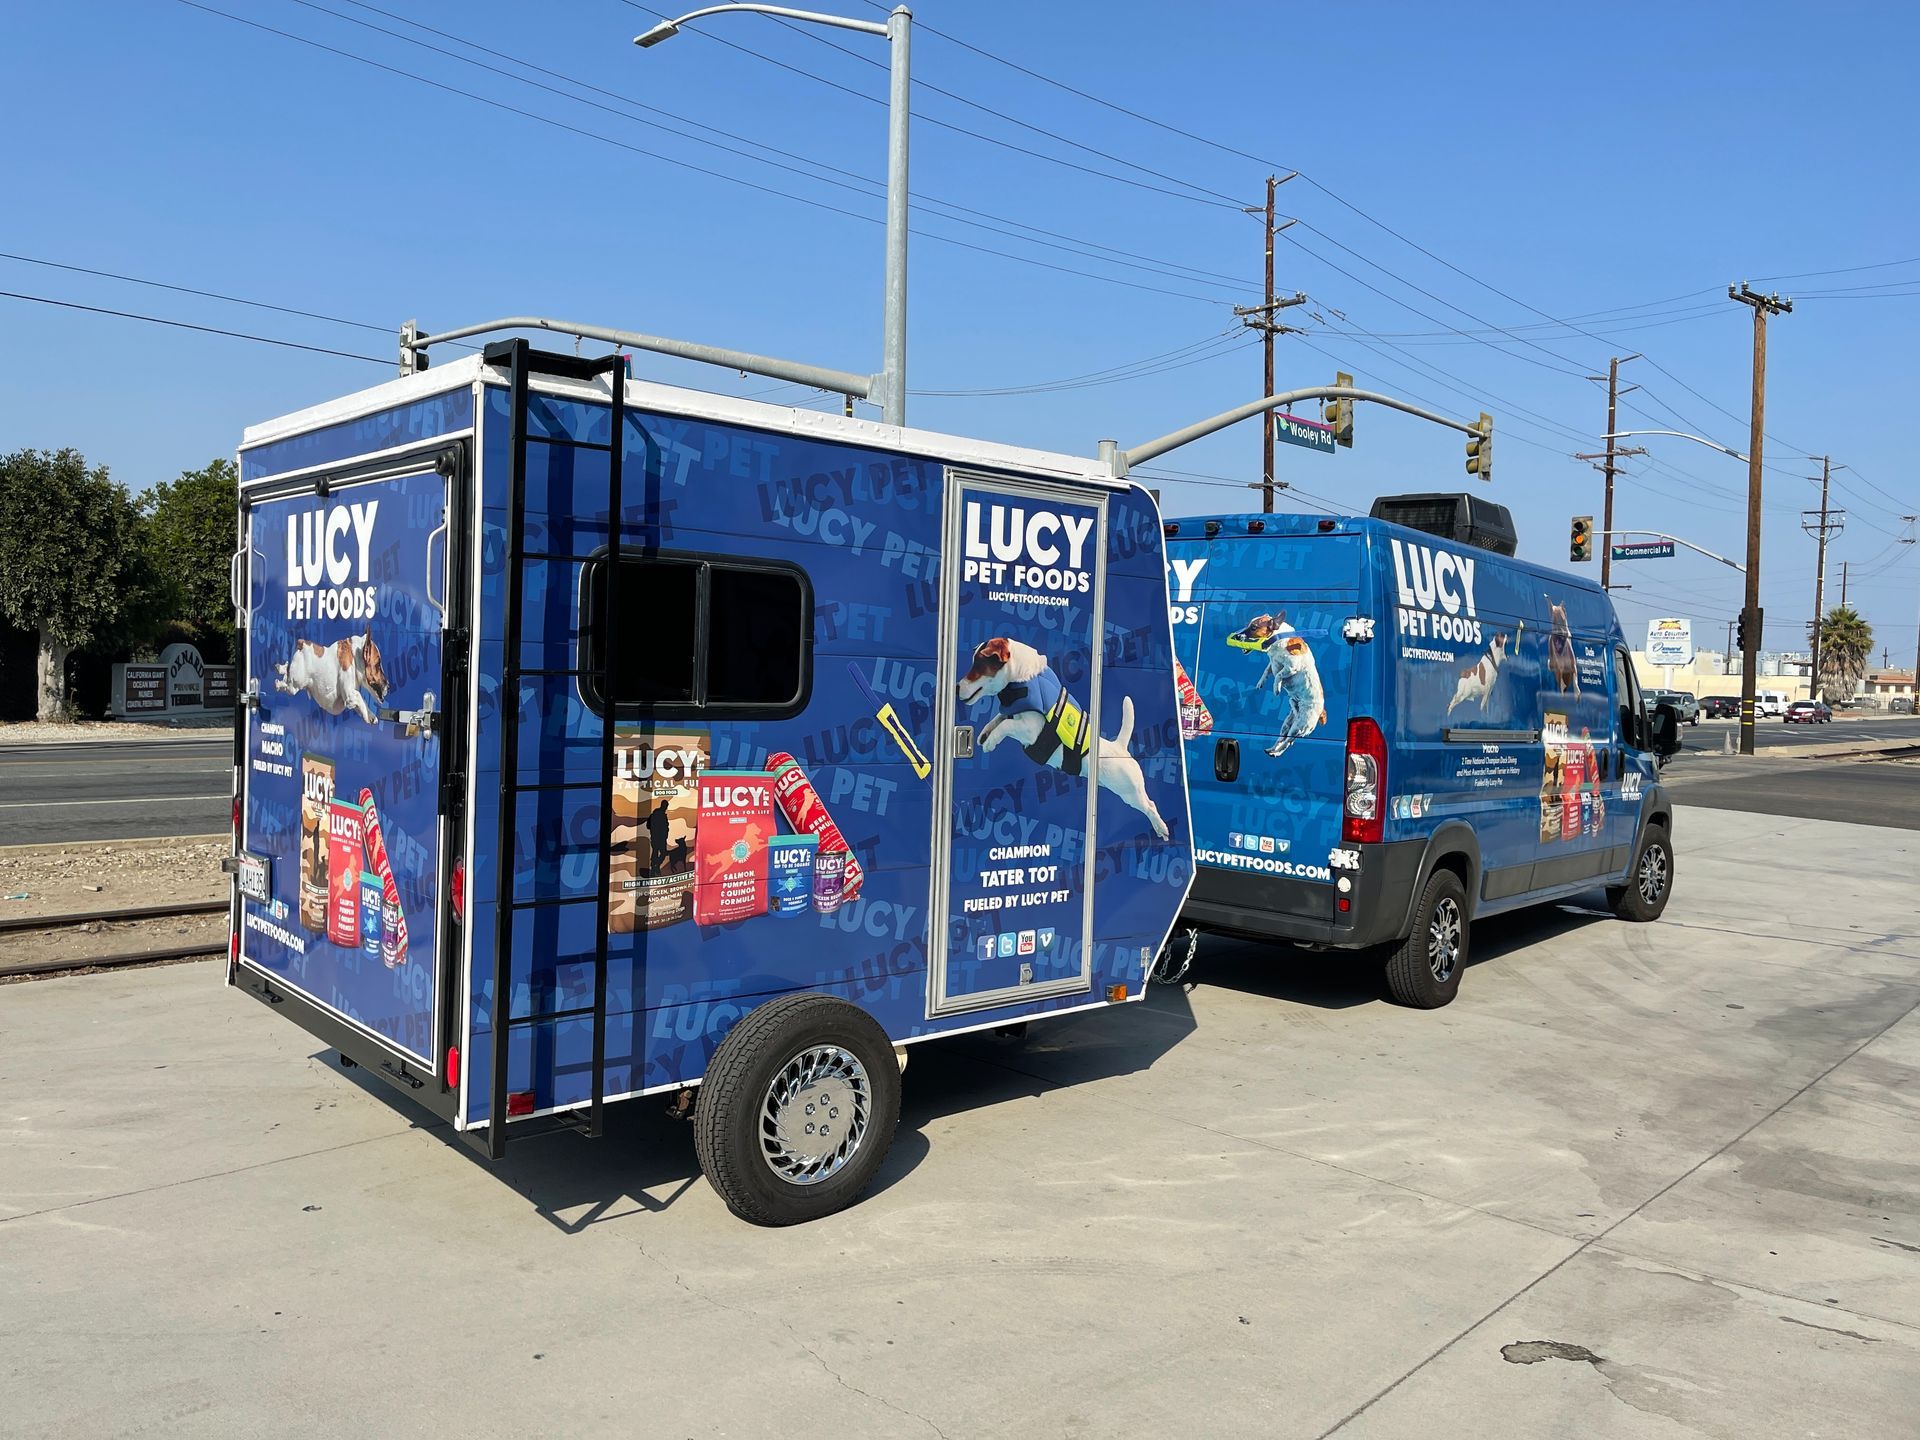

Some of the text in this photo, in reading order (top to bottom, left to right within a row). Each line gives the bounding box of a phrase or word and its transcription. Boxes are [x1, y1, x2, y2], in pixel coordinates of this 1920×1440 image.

[1290, 422, 1331, 445] Wooley Rd
[757, 467, 857, 523] LUCY
[287, 500, 379, 587] LUCY
[965, 501, 1095, 569] LUCY
[1625, 546, 1660, 555] Commercial
[964, 560, 1090, 593] PET FOODS
[1390, 538, 1476, 617] LUCY
[287, 586, 376, 620] PET FOODS
[989, 591, 1069, 607] LUCYPETFOODS.COM
[1398, 608, 1482, 645] PET FOODS
[171, 650, 204, 678] OXNARD
[1402, 647, 1455, 662] LUCYPETFOODS.COM
[261, 722, 284, 736] CHAMPION
[261, 740, 283, 757] MACHO
[803, 717, 880, 765] LUC
[617, 749, 698, 778] LUCY
[304, 771, 330, 804] LUCY
[617, 780, 674, 789] TACTICAL
[774, 769, 805, 797] LUCY
[1621, 773, 1642, 792] LUCY
[702, 786, 764, 808] LUCY
[331, 813, 358, 840] LUCY
[809, 815, 826, 830] BEEF
[774, 848, 807, 865] LUCY
[989, 844, 1050, 861] CHAMPION
[815, 858, 842, 870] LUCY
[642, 875, 687, 886] ENERGY/ACTIVE
[722, 879, 755, 889] PUMPKIN
[980, 865, 1057, 888] TATER TOT
[362, 887, 378, 905] LUCY
[670, 885, 687, 893] BROWN
[720, 894, 755, 906] FORMULA
[726, 886, 755, 897] QUINOA
[964, 889, 1069, 912] FUELED BY LUCY PET
[247, 912, 305, 955] LUCYPETFOODS.COM
